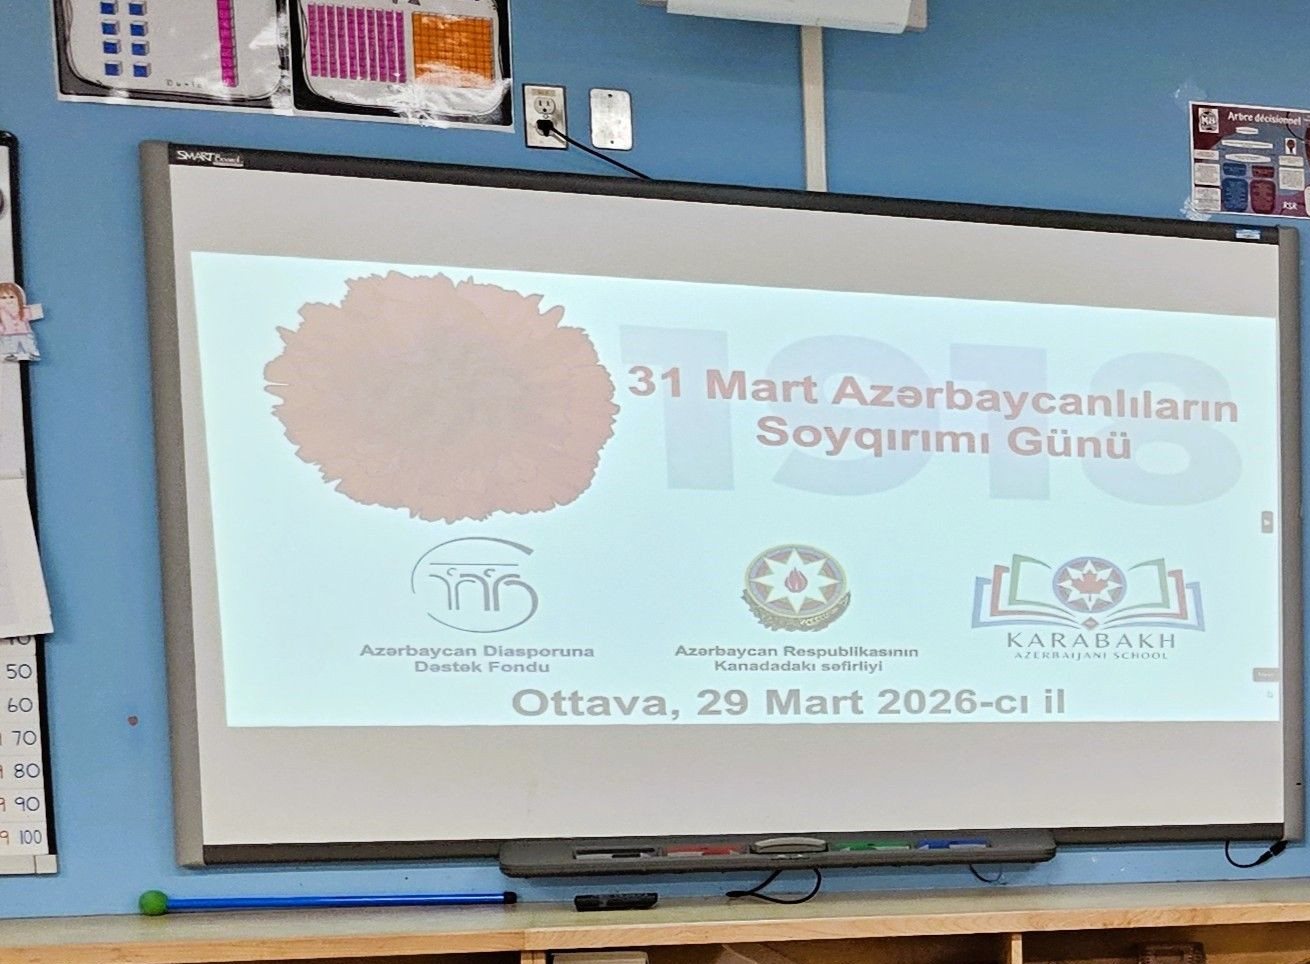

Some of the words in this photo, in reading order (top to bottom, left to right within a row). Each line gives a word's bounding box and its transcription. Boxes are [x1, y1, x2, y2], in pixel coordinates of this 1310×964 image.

[177, 150, 215, 161] SMART
[628, 365, 682, 398] 31
[706, 368, 818, 404] Mart
[831, 375, 1238, 422] Azərbaycanlıların
[756, 415, 990, 458] Soyqırımı
[1007, 426, 1132, 459] Günü
[1007, 632, 1175, 649] KARABAKH
[360, 644, 477, 660] Azərbaycan
[483, 645, 595, 660] Diasporuna
[675, 645, 778, 659] Azərbaycan
[783, 646, 919, 660] Respublikasının
[1014, 651, 1107, 661] AZERBAIJANI
[1113, 651, 1168, 660] SCHOOL
[7, 663, 33, 679] 50
[415, 660, 482, 673] Dəstək
[488, 660, 550, 673] Fondu
[714, 660, 816, 672] Kanadadakı
[821, 660, 883, 674] səfirliyi
[7, 697, 33, 713] 60
[512, 688, 679, 720] Ottava,
[697, 689, 749, 716] 29
[766, 689, 864, 716] Mart
[877, 688, 1028, 716] 2026-cı
[1045, 688, 1065, 714] il
[11, 730, 37, 746] 70
[14, 763, 40, 778] 80
[14, 796, 40, 812] 90
[20, 829, 42, 845] 100
